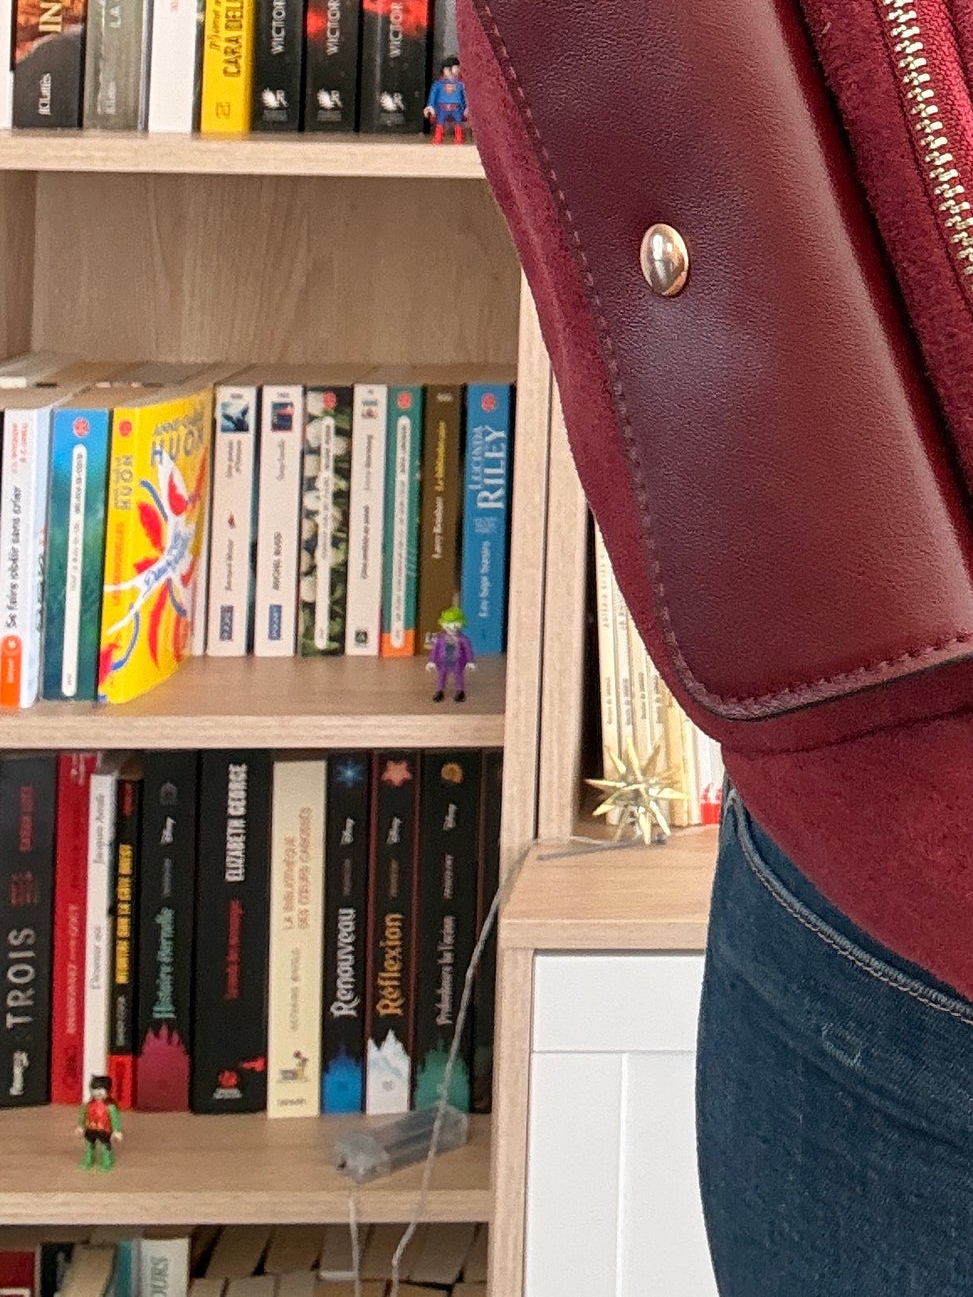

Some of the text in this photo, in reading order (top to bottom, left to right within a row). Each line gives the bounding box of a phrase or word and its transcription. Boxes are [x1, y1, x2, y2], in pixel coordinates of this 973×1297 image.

[110, 6, 122, 28] LA
[326, 0, 342, 56] VICTOR
[388, 2, 404, 59] VICTOR
[223, 35, 244, 79] CARA
[468, 425, 484, 490] LUCINDA
[476, 424, 506, 509] RILEY
[10, 485, 22, 515] crier
[10, 517, 21, 545] sans
[5, 613, 18, 629] Se
[6, 583, 19, 611] faire
[224, 763, 248, 882] ELIZABETH GEORGE
[340, 816, 356, 846] Disney
[386, 816, 402, 846] Disney
[442, 803, 458, 831] Disney
[6, 927, 36, 1029] TROIS
[329, 908, 361, 1018] Renouveau
[375, 912, 406, 1017] Réflexion
[152, 963, 176, 1019] Histoire
